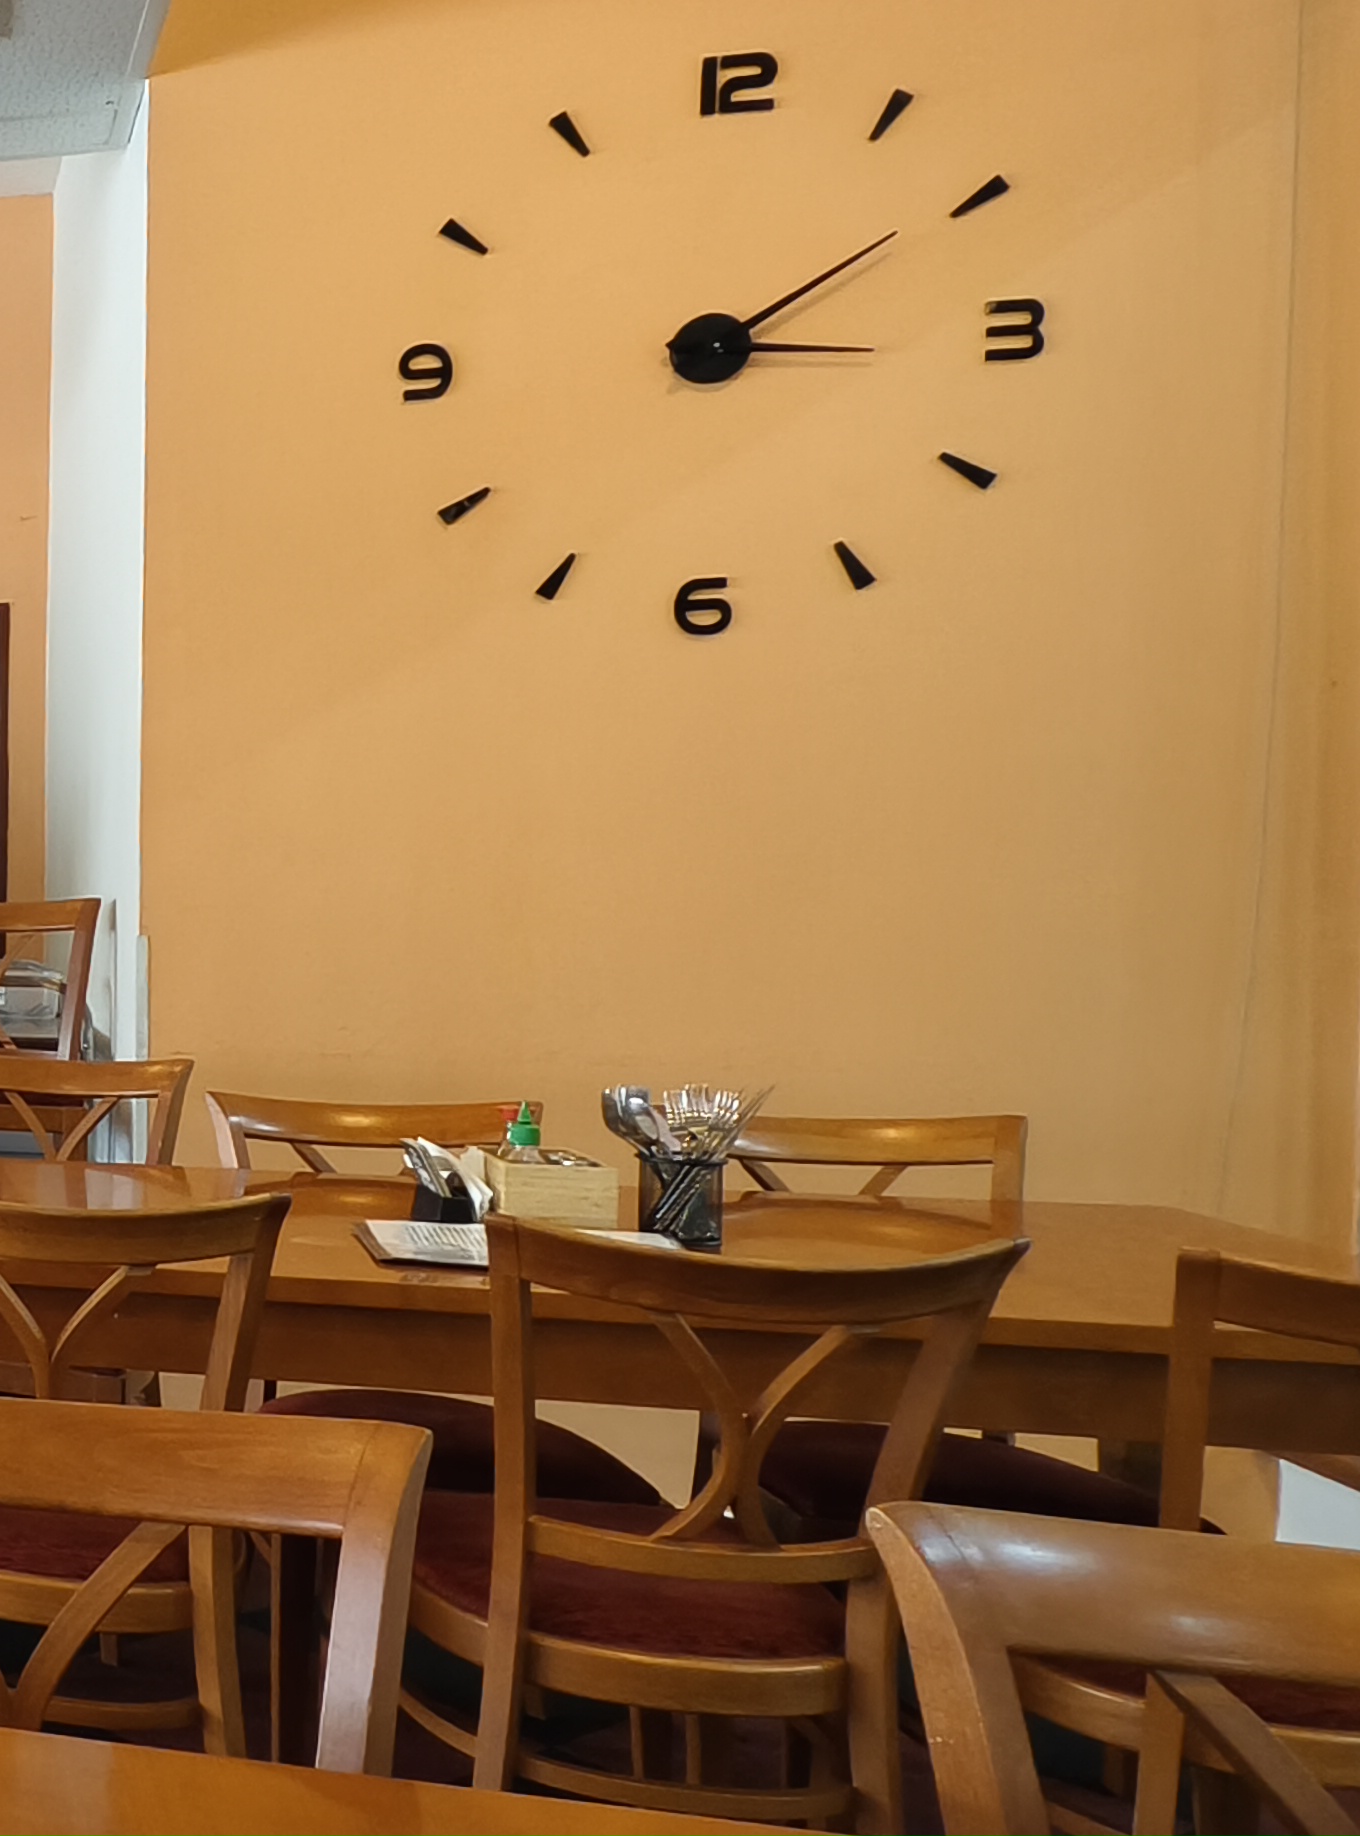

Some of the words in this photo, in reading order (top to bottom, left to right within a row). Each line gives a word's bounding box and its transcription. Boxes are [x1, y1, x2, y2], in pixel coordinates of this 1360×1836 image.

[699, 51, 779, 117] 12
[984, 298, 1045, 362] 3
[398, 343, 453, 402] 9
[673, 576, 732, 636] 6
